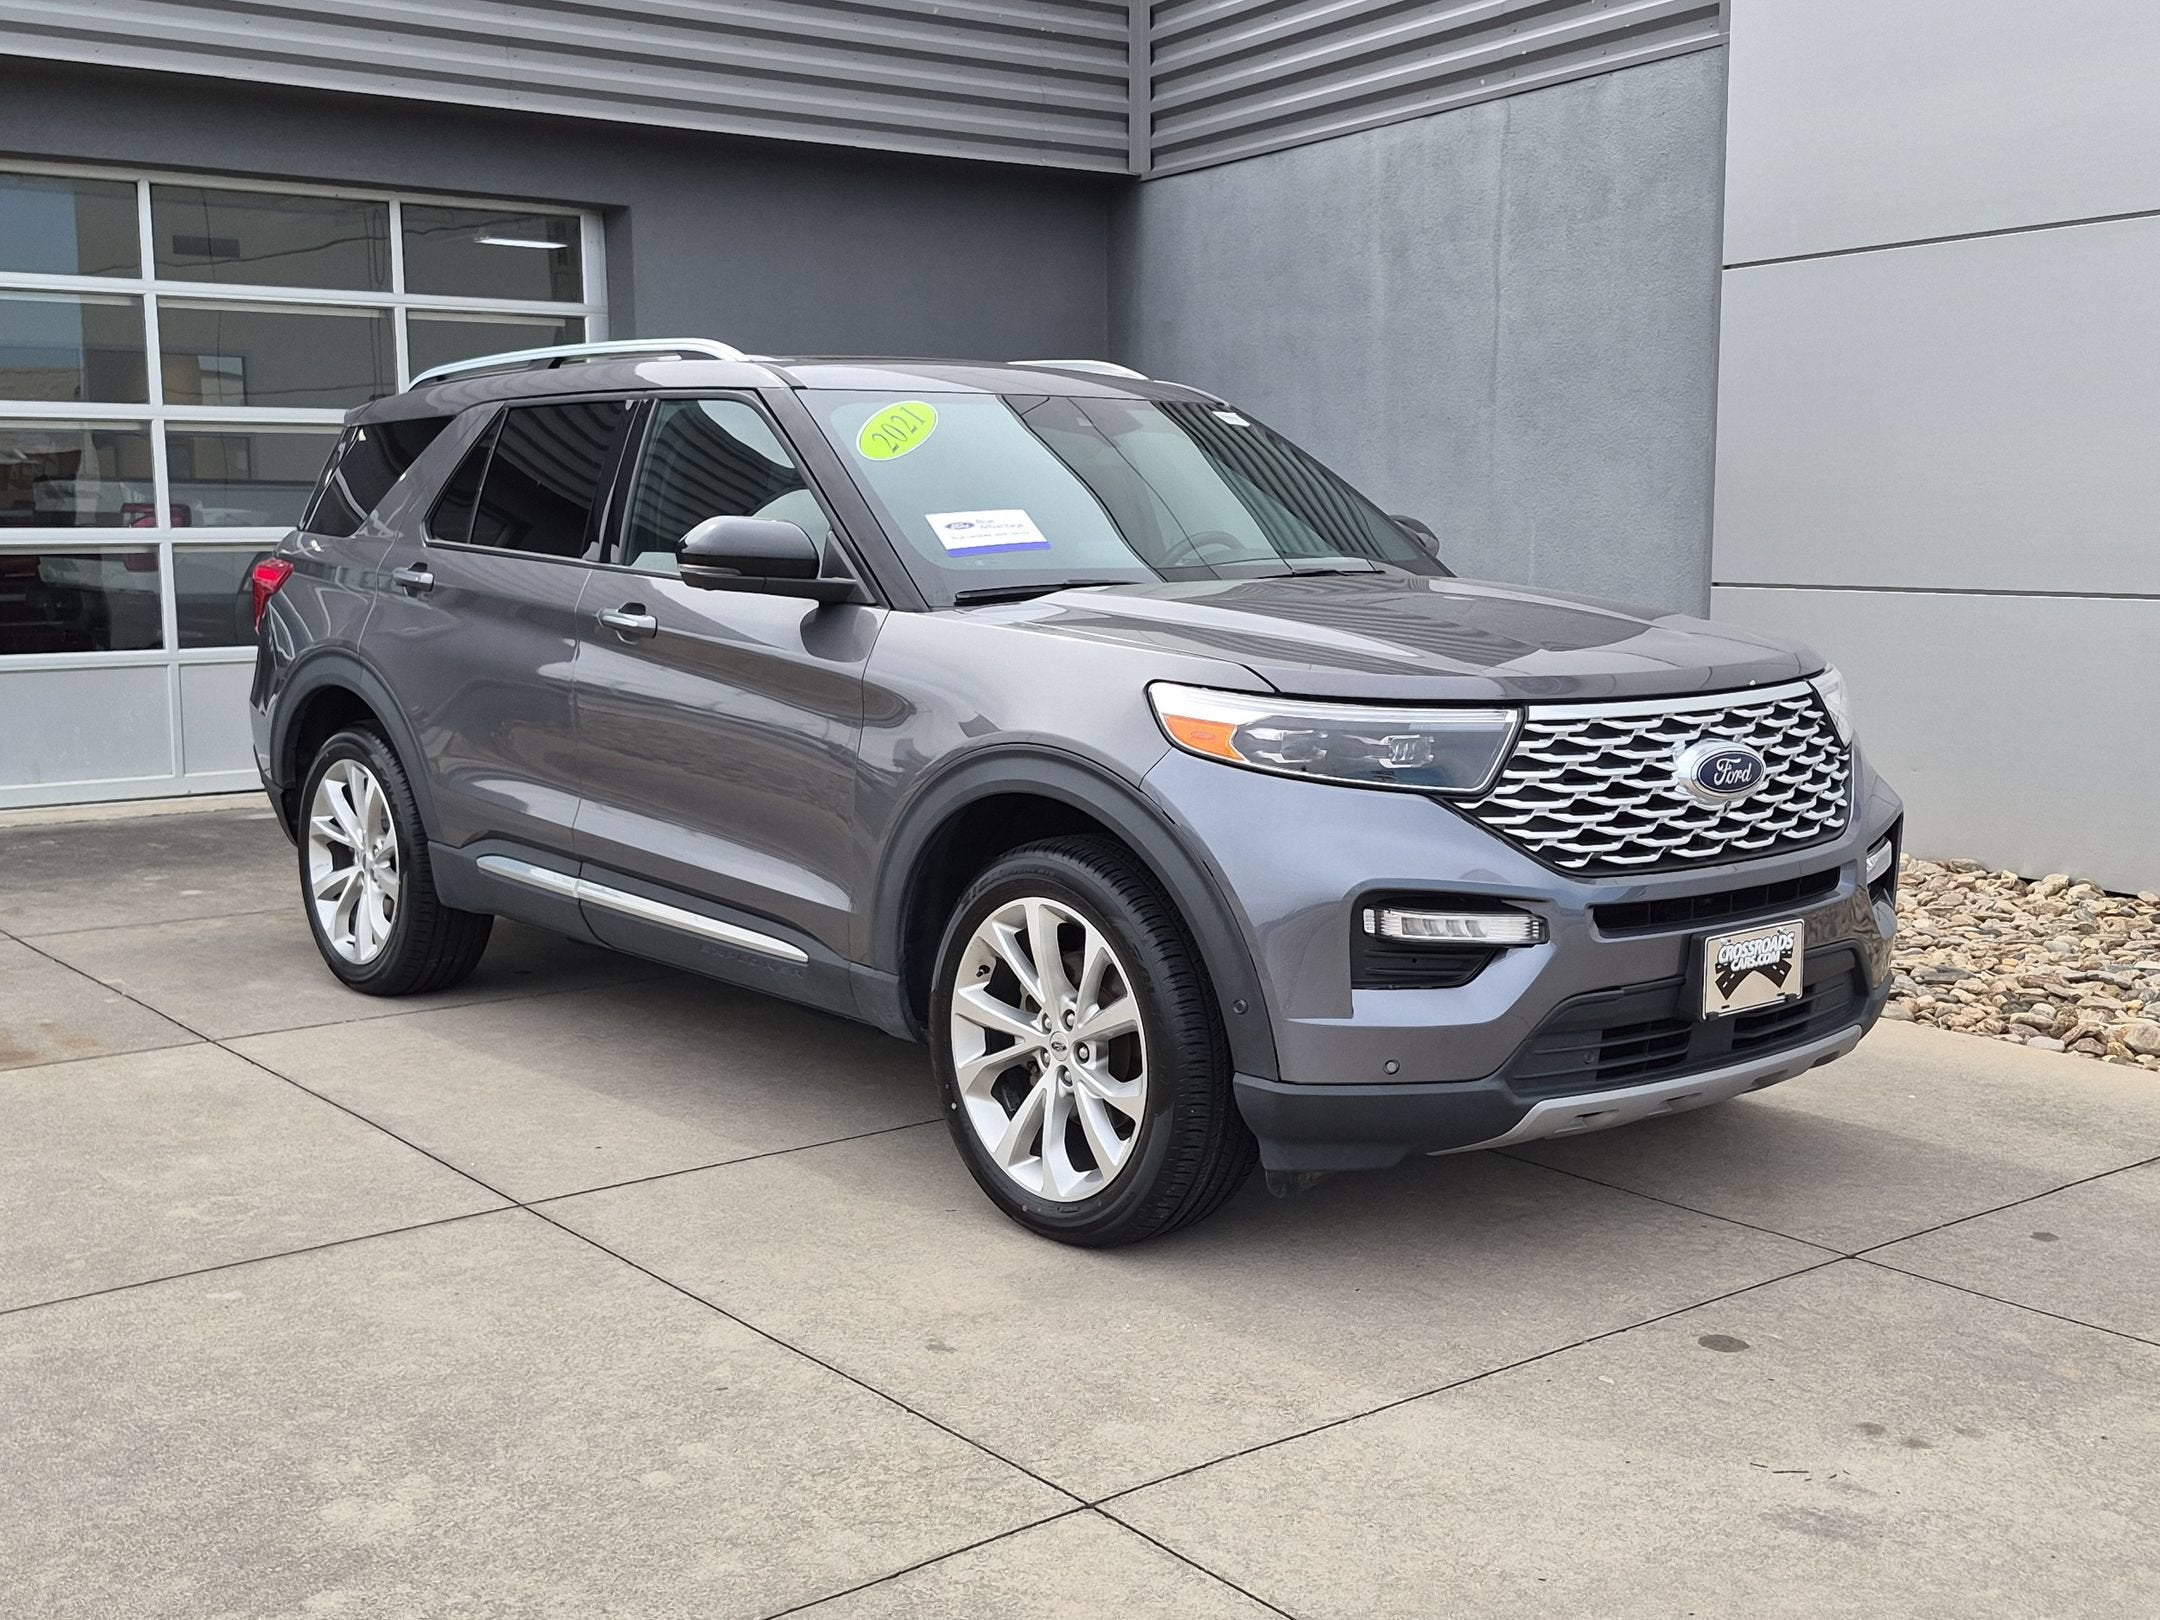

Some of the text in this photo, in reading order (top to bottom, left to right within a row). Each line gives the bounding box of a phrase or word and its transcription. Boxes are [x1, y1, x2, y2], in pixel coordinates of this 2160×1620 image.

[871, 406, 925, 452] 2021
[1713, 757, 1753, 786] Ford
[1718, 931, 1795, 963] CROSSROADS
[1730, 951, 1780, 972] CARS.COM
